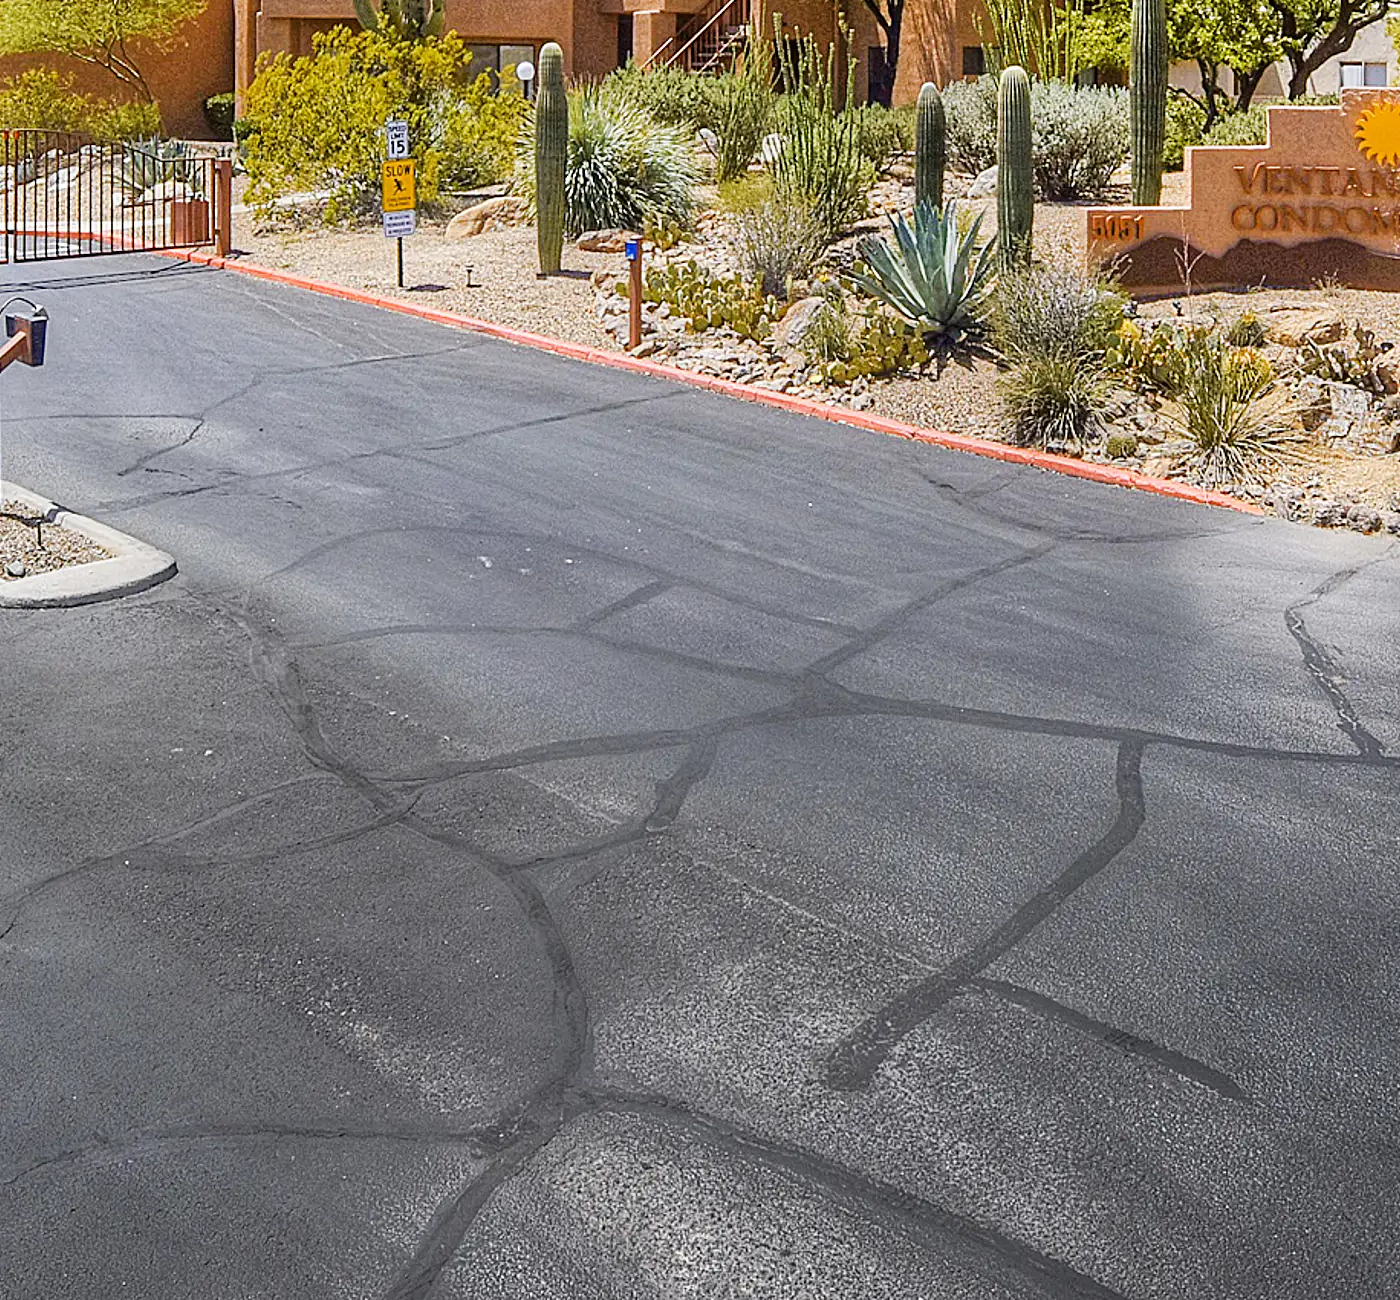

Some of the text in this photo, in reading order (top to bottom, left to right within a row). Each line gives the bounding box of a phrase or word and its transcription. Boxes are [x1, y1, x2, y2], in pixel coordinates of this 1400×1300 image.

[391, 140, 405, 154] 15
[386, 164, 411, 178] SLOW
[1092, 214, 1144, 241] 5051
